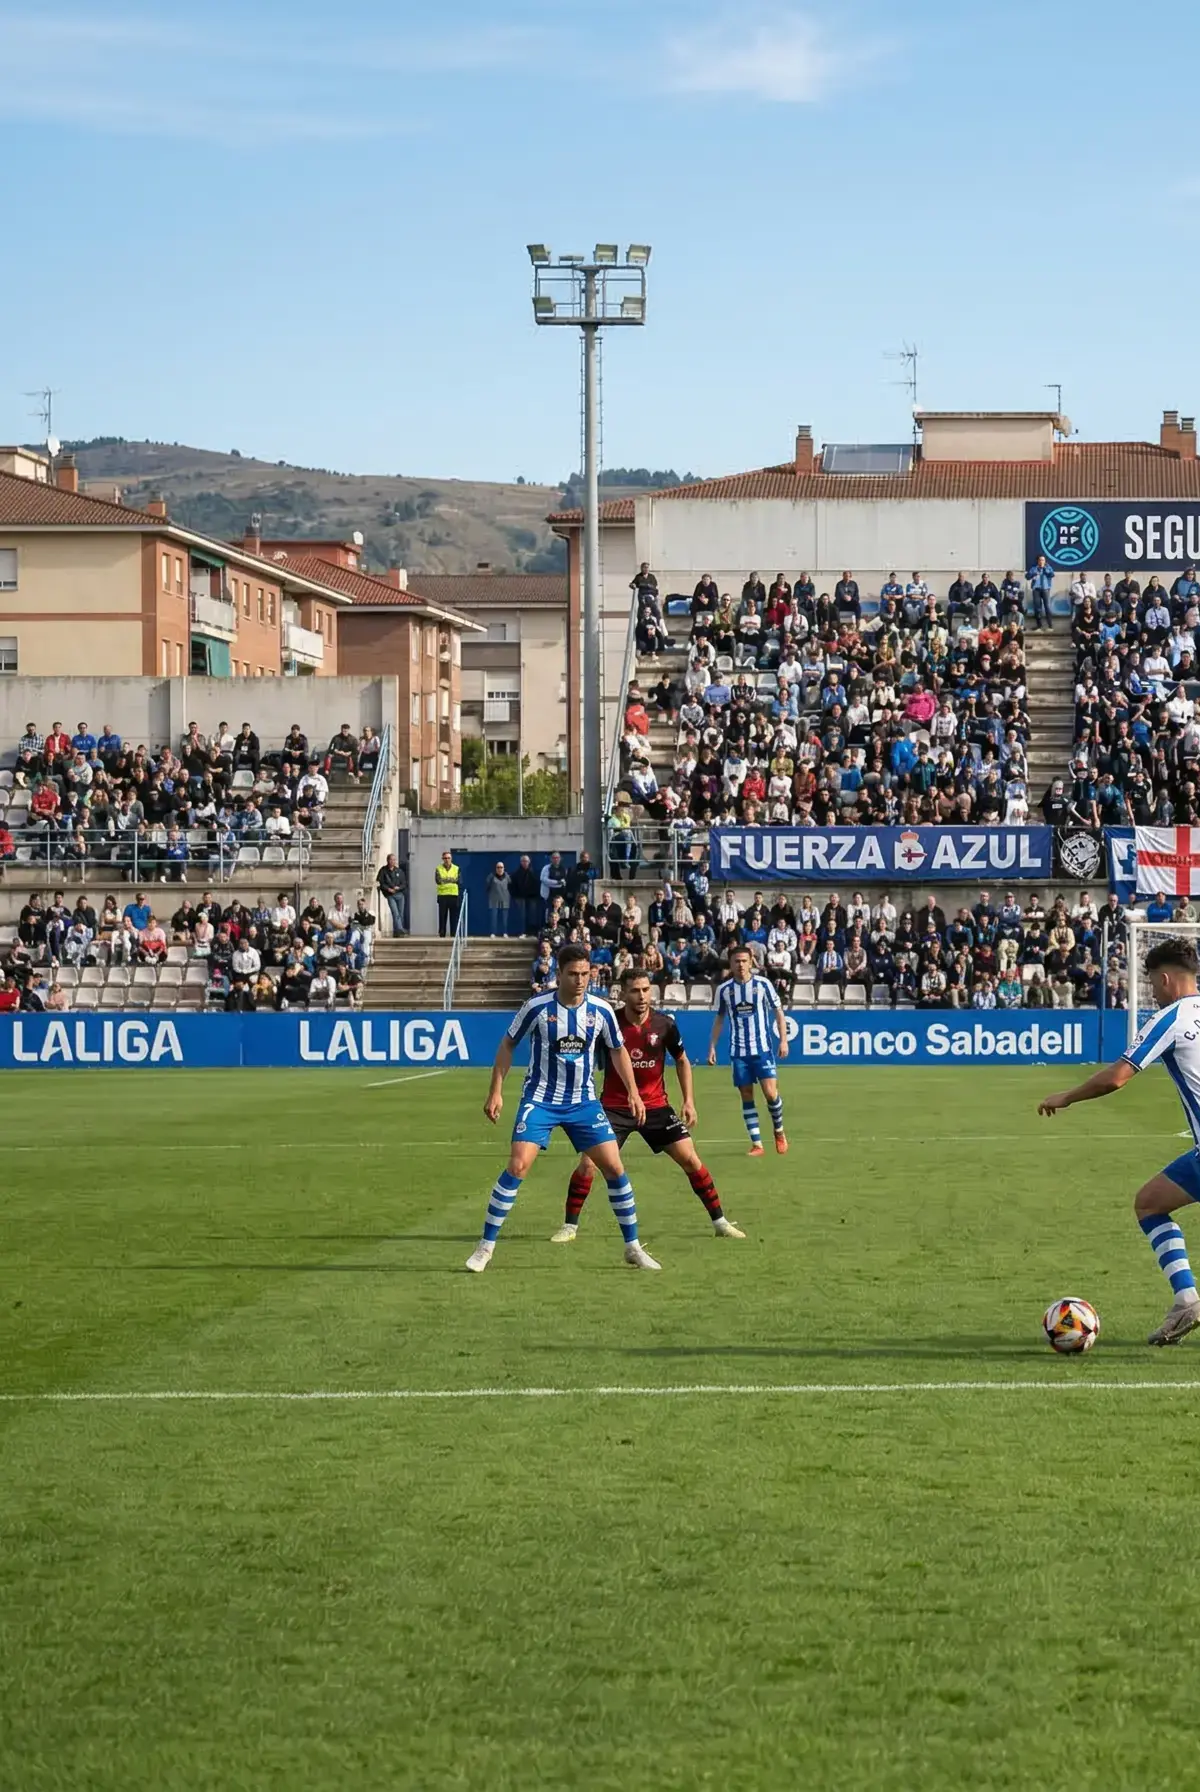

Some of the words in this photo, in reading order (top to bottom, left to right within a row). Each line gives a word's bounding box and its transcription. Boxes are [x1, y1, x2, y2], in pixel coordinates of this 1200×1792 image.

[718, 835, 886, 870] FUERZA
[931, 833, 1042, 870] AZUL
[12, 1020, 184, 1062] LALIGA
[299, 1019, 469, 1061] LALIGA
[802, 1023, 917, 1057] Banco
[926, 1021, 1083, 1058] Sabadell
[522, 1103, 535, 1123] 7
